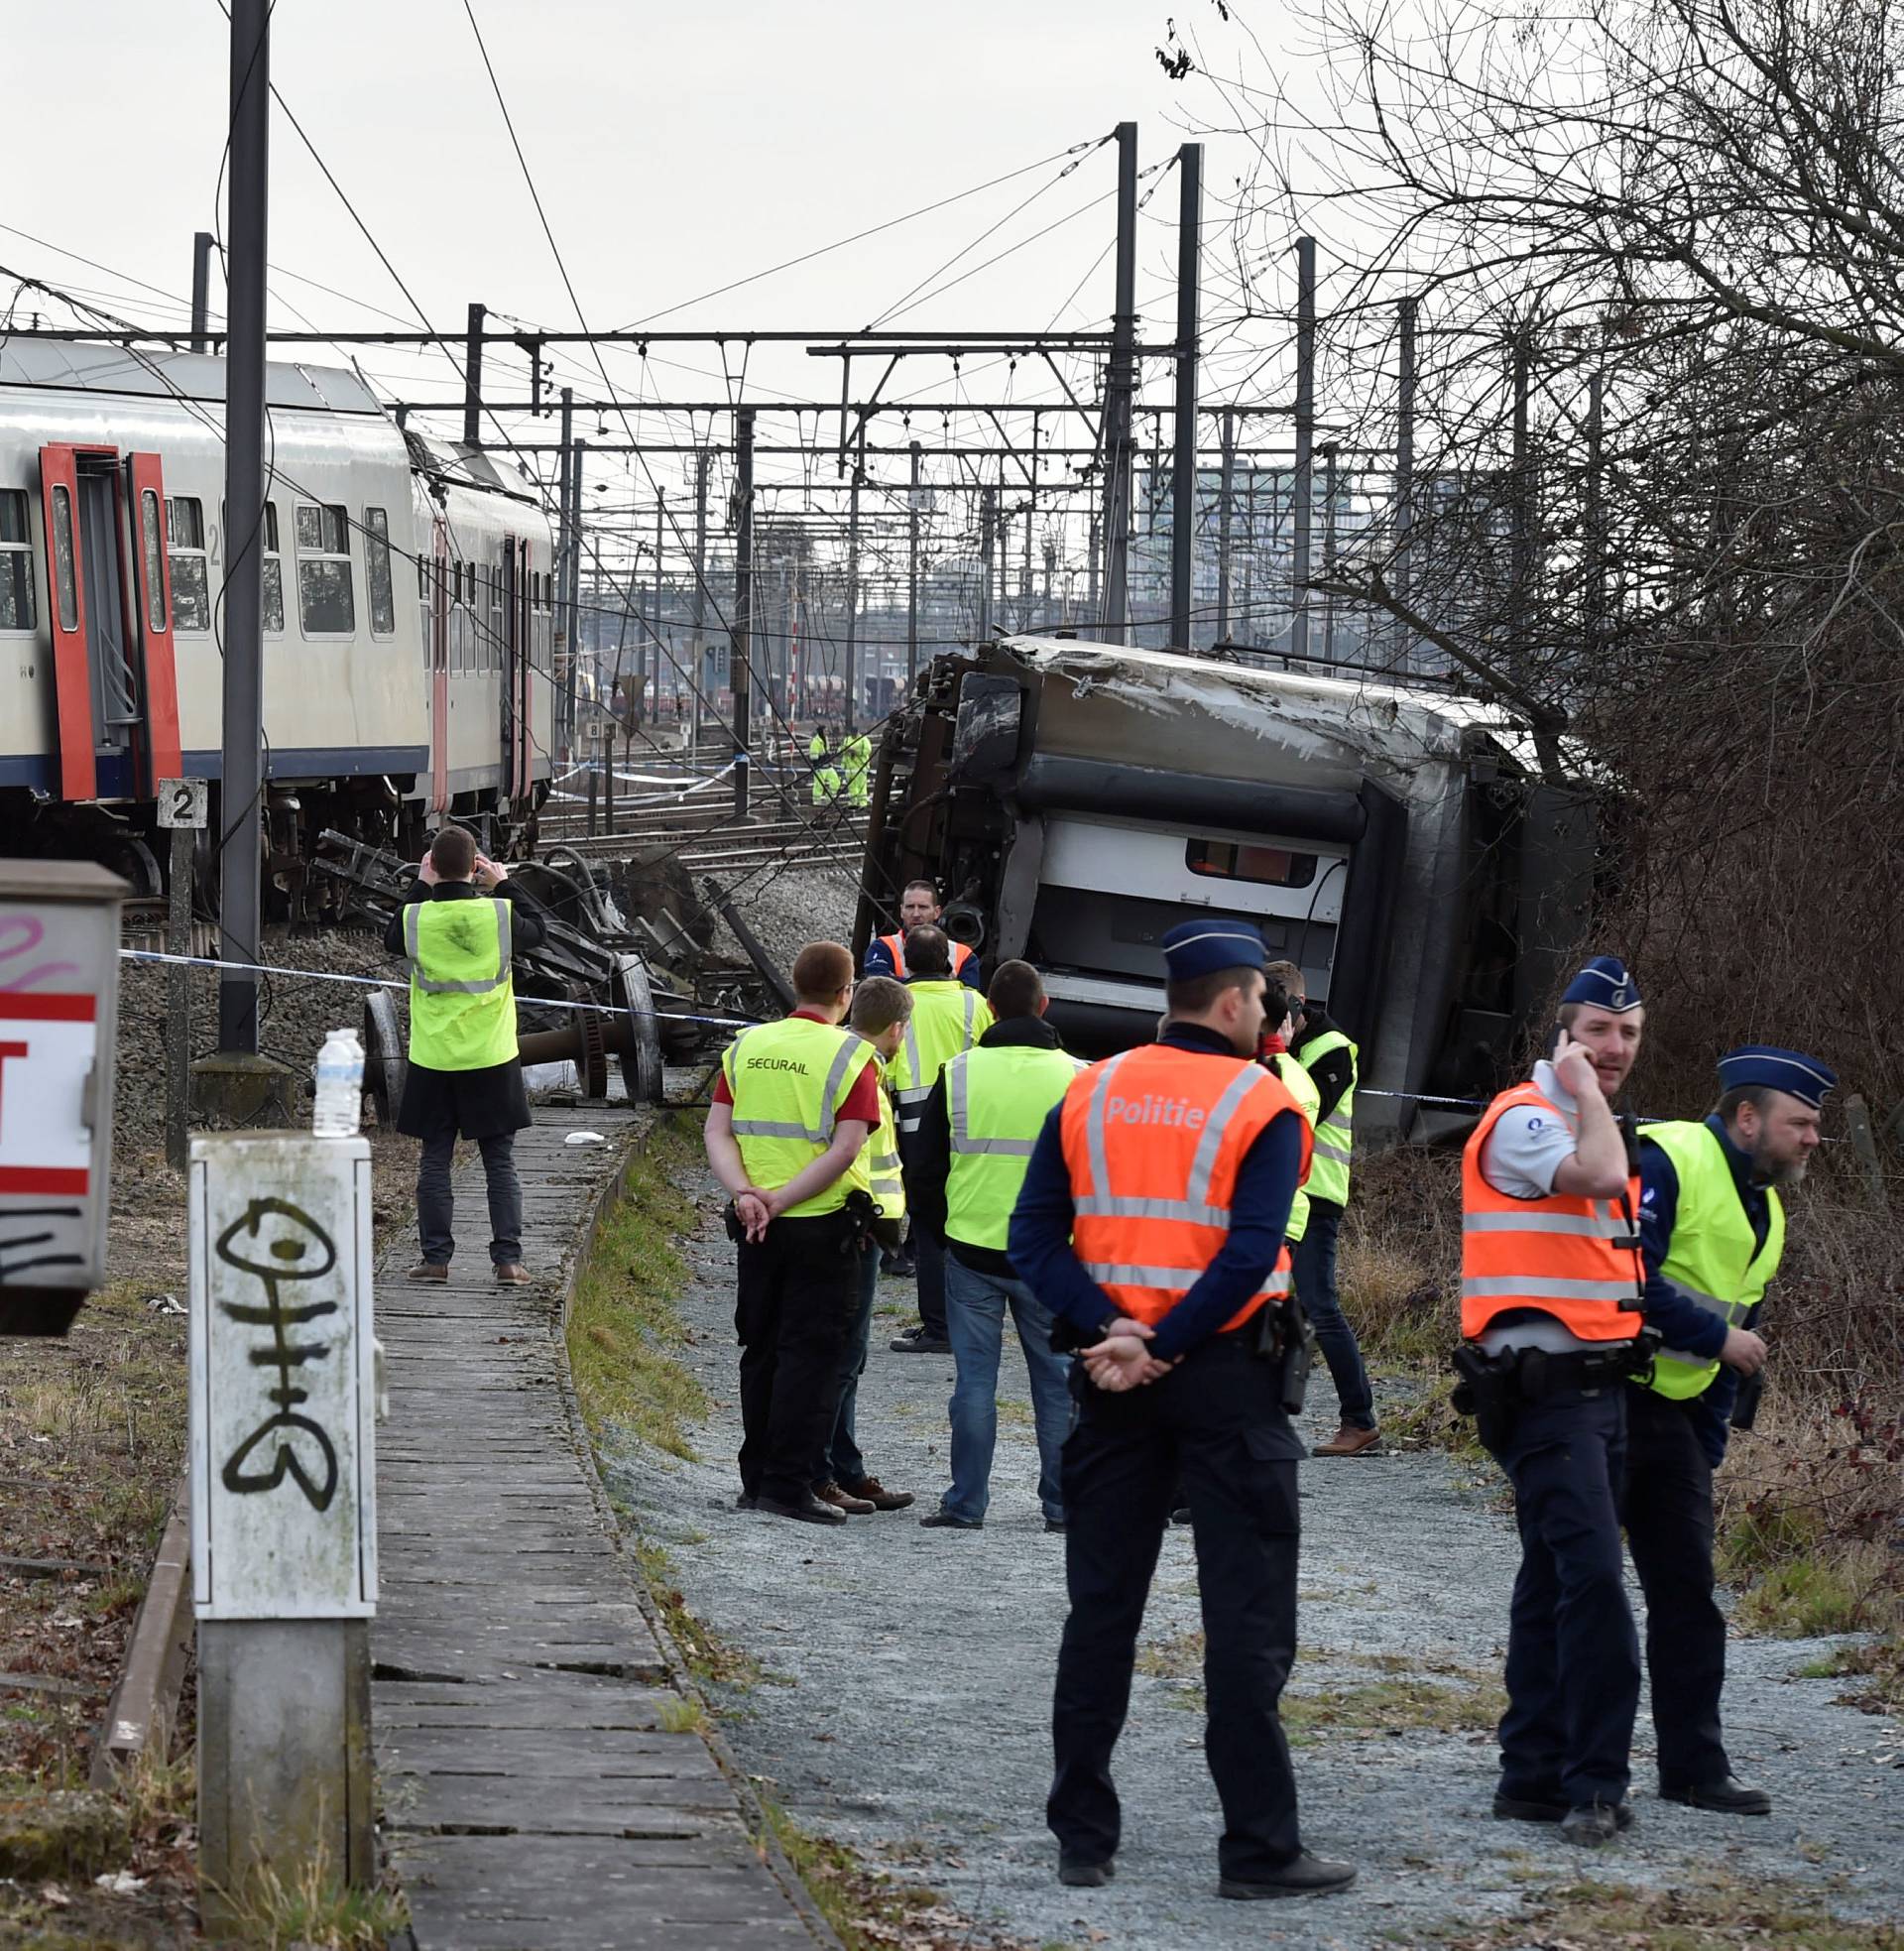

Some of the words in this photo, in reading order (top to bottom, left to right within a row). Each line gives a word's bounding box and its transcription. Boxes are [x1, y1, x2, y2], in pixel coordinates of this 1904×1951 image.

[208, 524, 221, 566] 2
[173, 789, 193, 819] 2
[747, 1057, 809, 1076] SECURAIL
[1106, 1094, 1205, 1130] Politie
